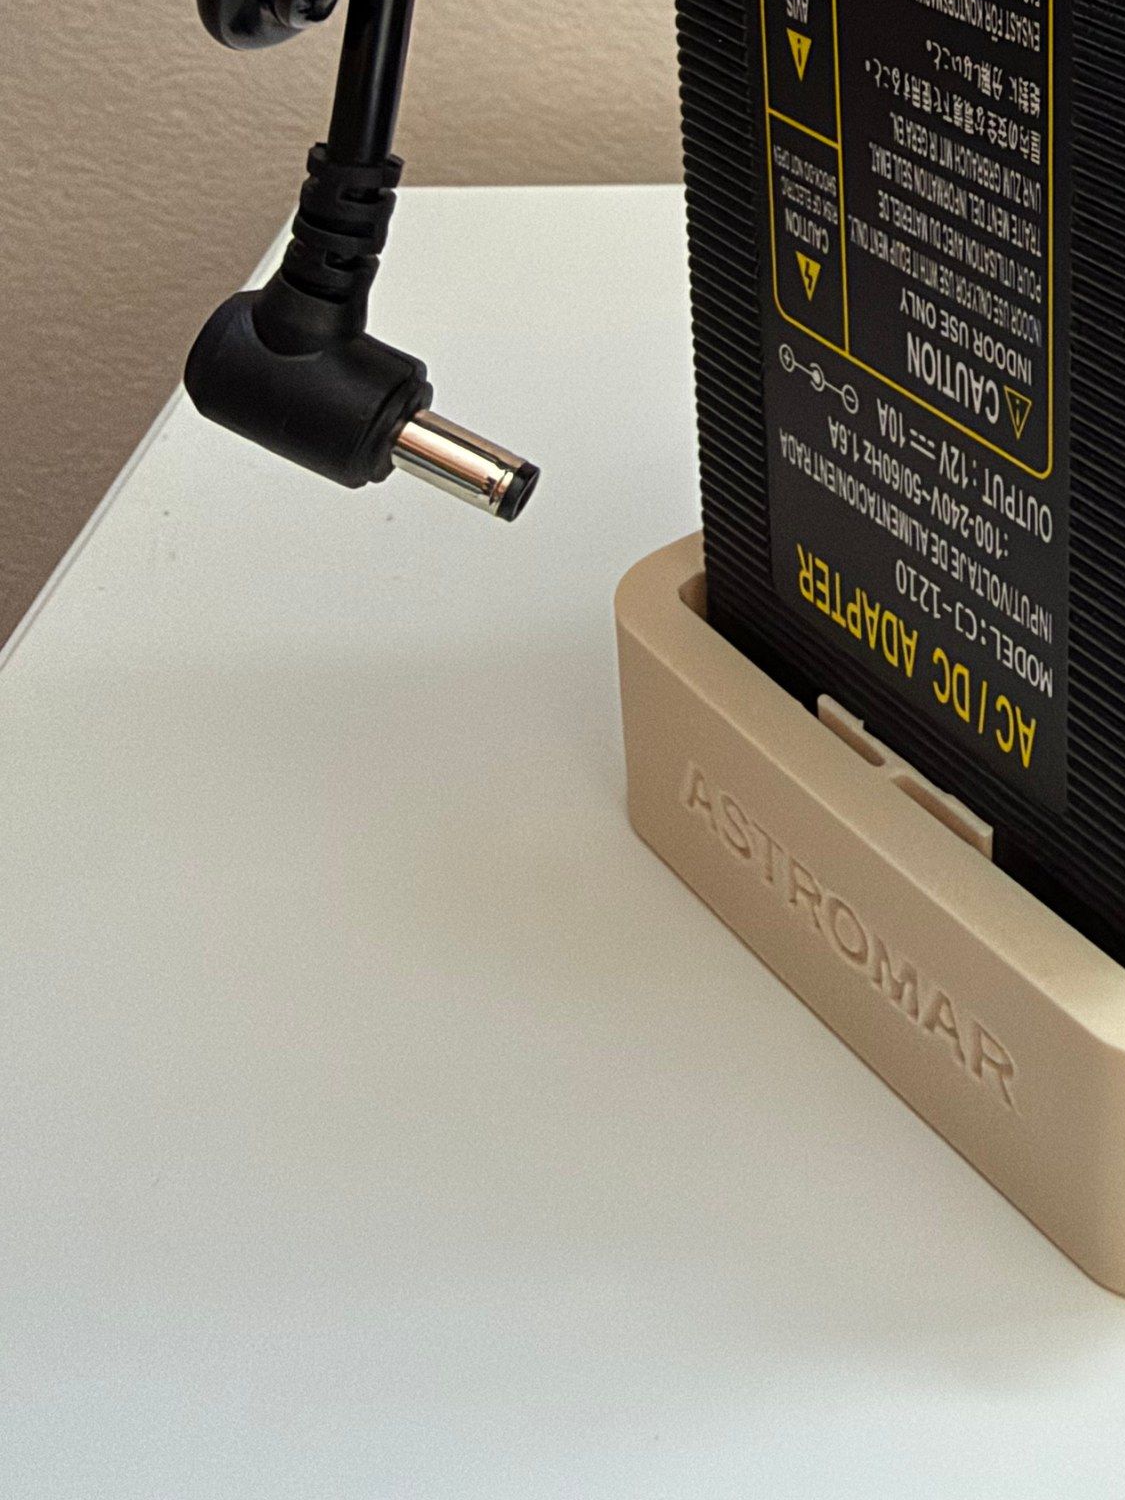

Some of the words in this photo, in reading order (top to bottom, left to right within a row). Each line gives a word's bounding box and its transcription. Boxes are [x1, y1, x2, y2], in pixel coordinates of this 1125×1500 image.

[784, 207, 828, 254] CAUTION
[899, 287, 936, 329] ONLY
[939, 309, 968, 349] USE
[906, 331, 999, 424] CAUTION
[972, 327, 1031, 385] INDOOR
[827, 415, 859, 462] 1.6A
[876, 397, 905, 448] 10A
[796, 543, 918, 677] ADAPTER
[686, 765, 1020, 1112] ASTROMAR
